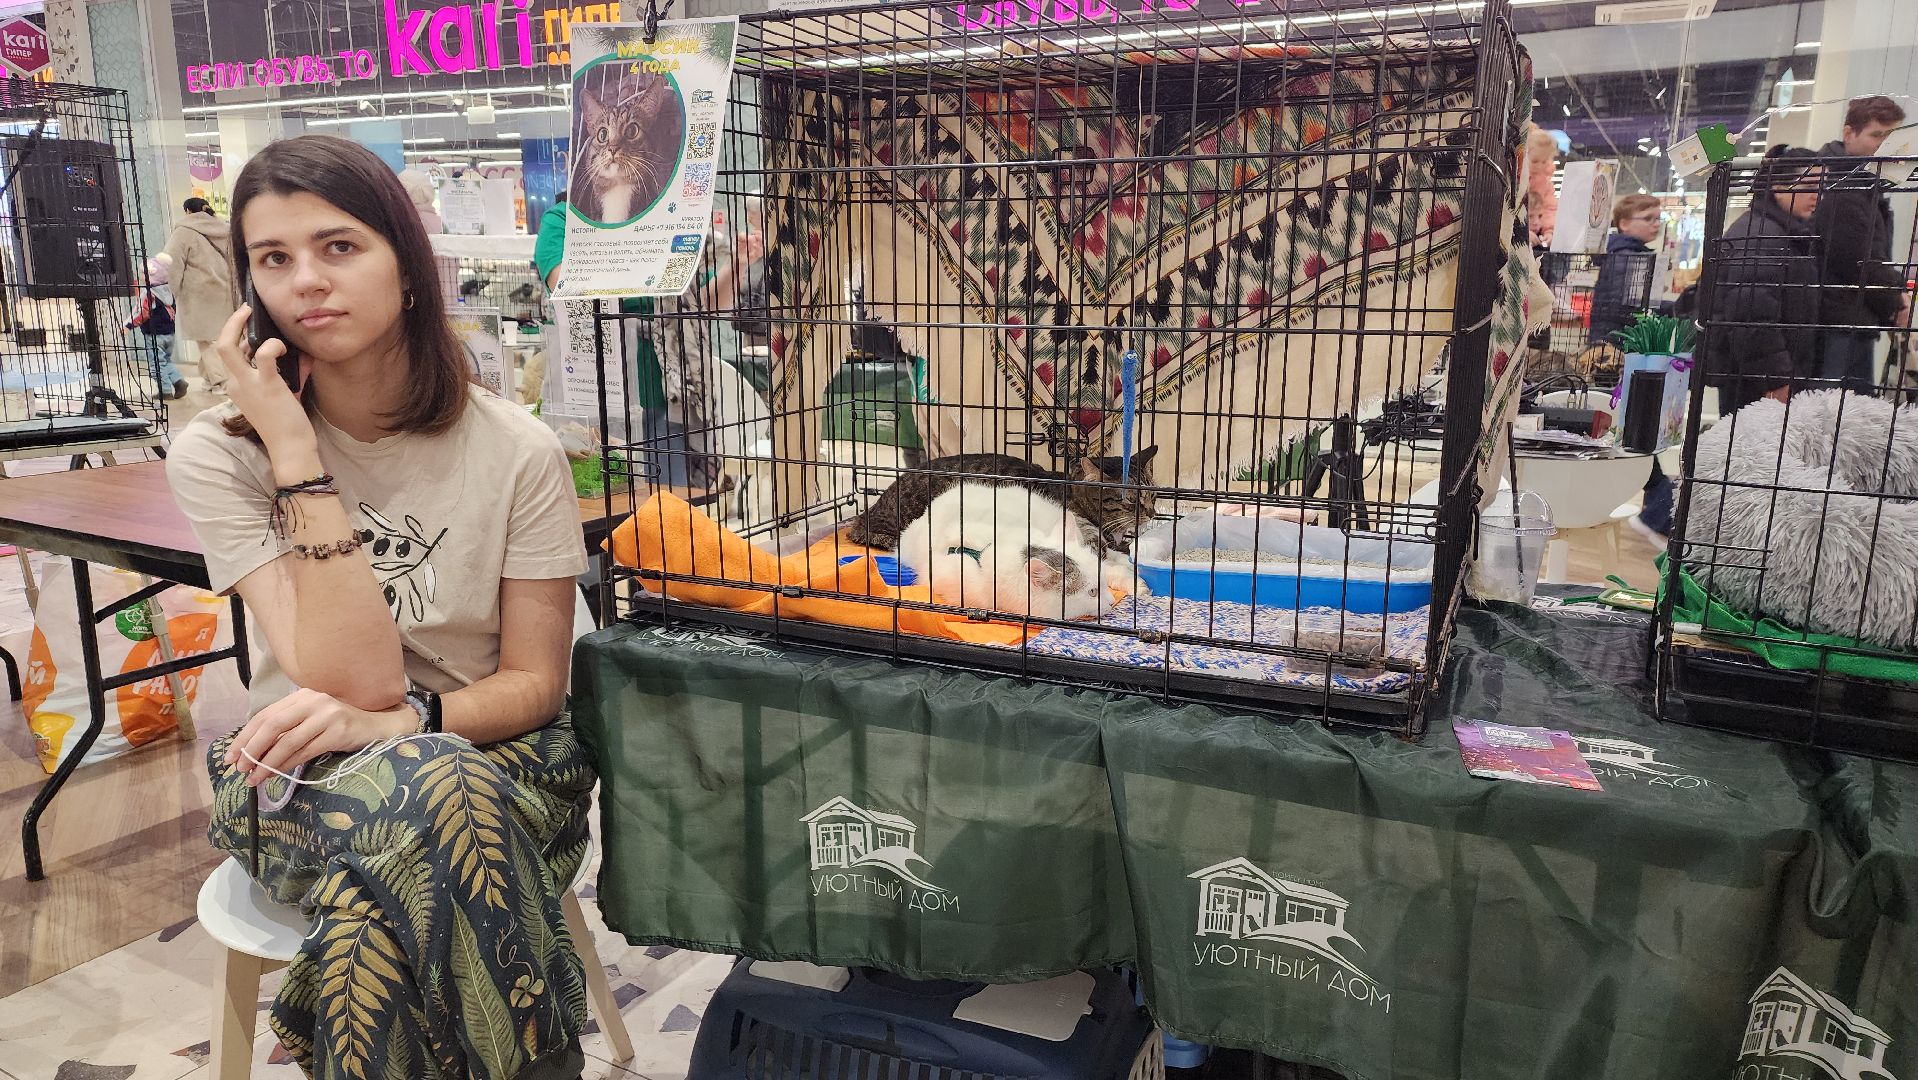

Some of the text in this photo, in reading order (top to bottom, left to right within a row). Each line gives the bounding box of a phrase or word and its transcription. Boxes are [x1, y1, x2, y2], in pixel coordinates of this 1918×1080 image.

[3, 30, 45, 50] kari
[6, 48, 32, 58] ГИПЕР
[384, 0, 533, 77] kari
[186, 62, 245, 93] ЕСЛИ
[339, 49, 374, 80] ТО
[630, 62, 640, 74] 4
[810, 873, 960, 915] УЮТНЫЙ ДОМ
[1193, 942, 1391, 1014] УЮТНЫЙ ДОМ
